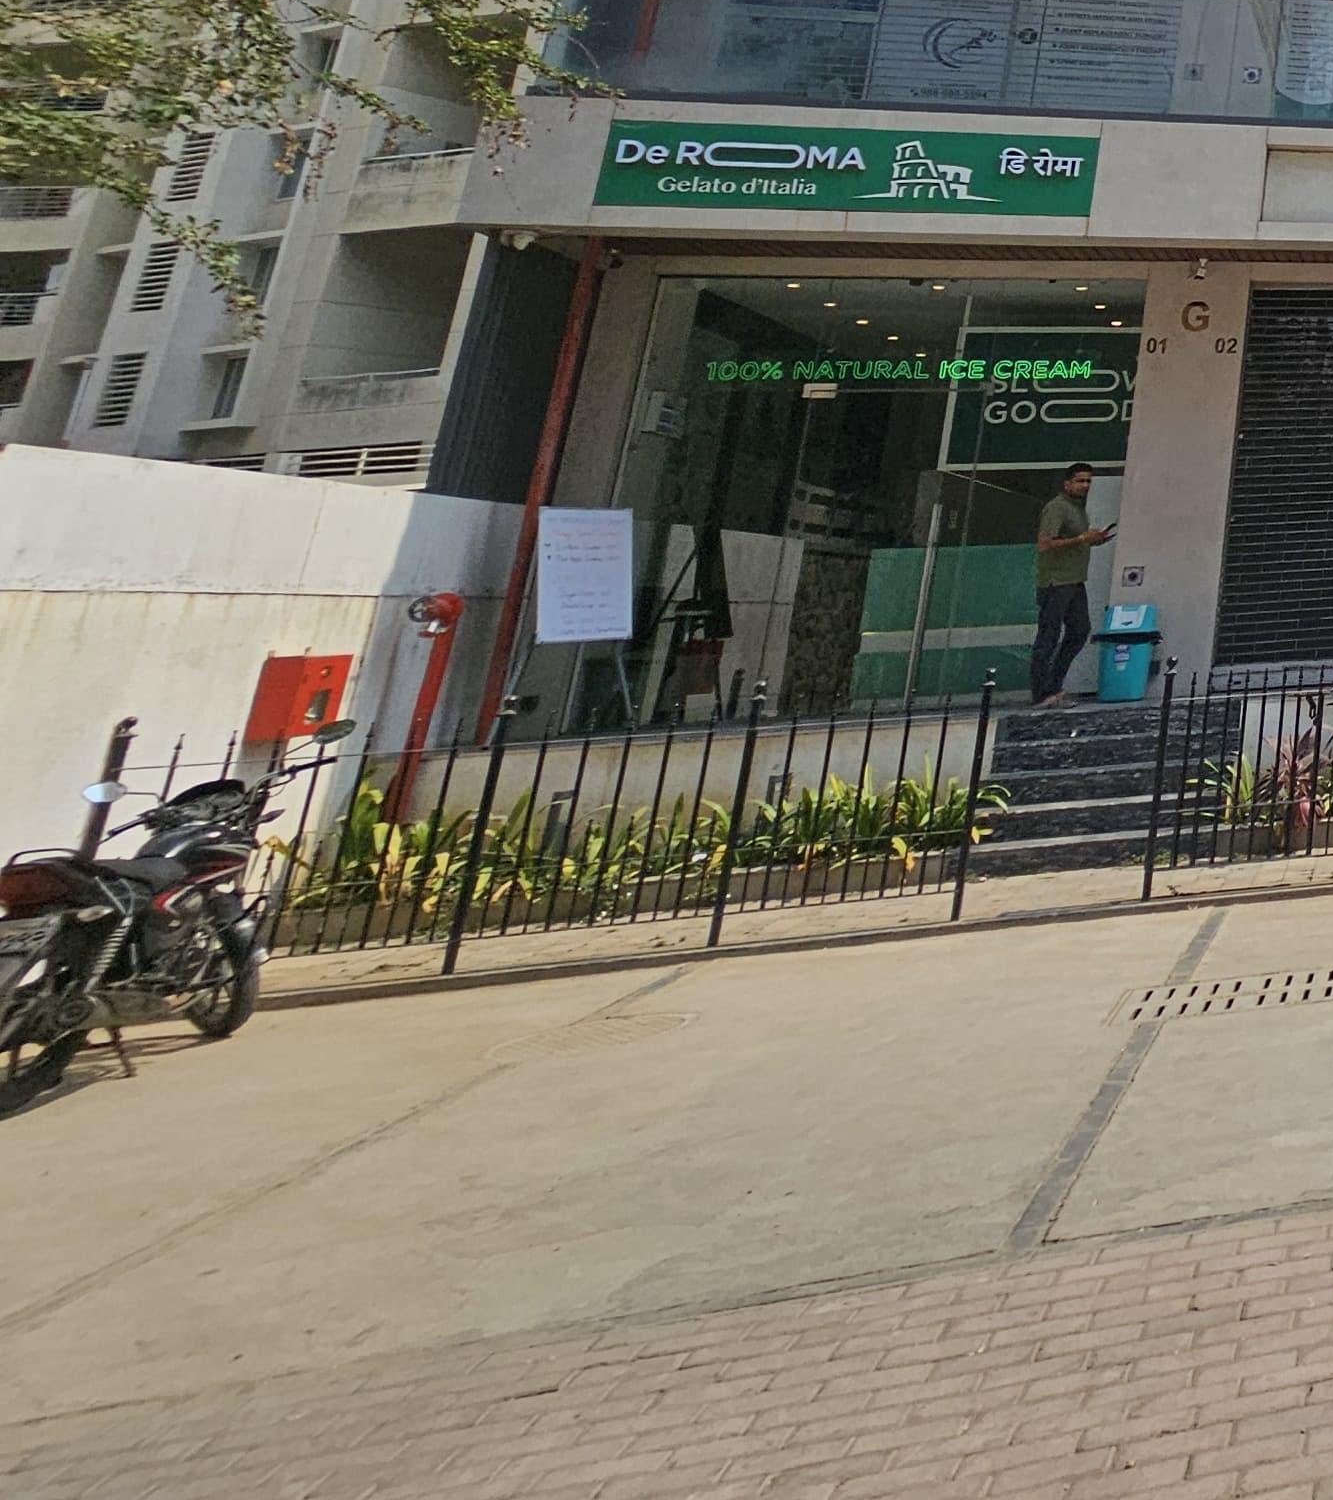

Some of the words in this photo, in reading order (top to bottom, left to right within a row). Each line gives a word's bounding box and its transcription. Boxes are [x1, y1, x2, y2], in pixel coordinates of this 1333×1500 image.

[614, 138, 670, 165] De
[1033, 151, 1084, 178] रोमा
[657, 176, 736, 196] Gelato
[740, 176, 817, 196] d'Italia
[1181, 301, 1210, 332] G
[1147, 338, 1168, 355] 01
[1215, 338, 1238, 354] 02
[706, 361, 784, 381] 100%
[792, 361, 930, 380] NATURAL
[938, 361, 986, 380] ICE
[992, 361, 1093, 380] CREAM
